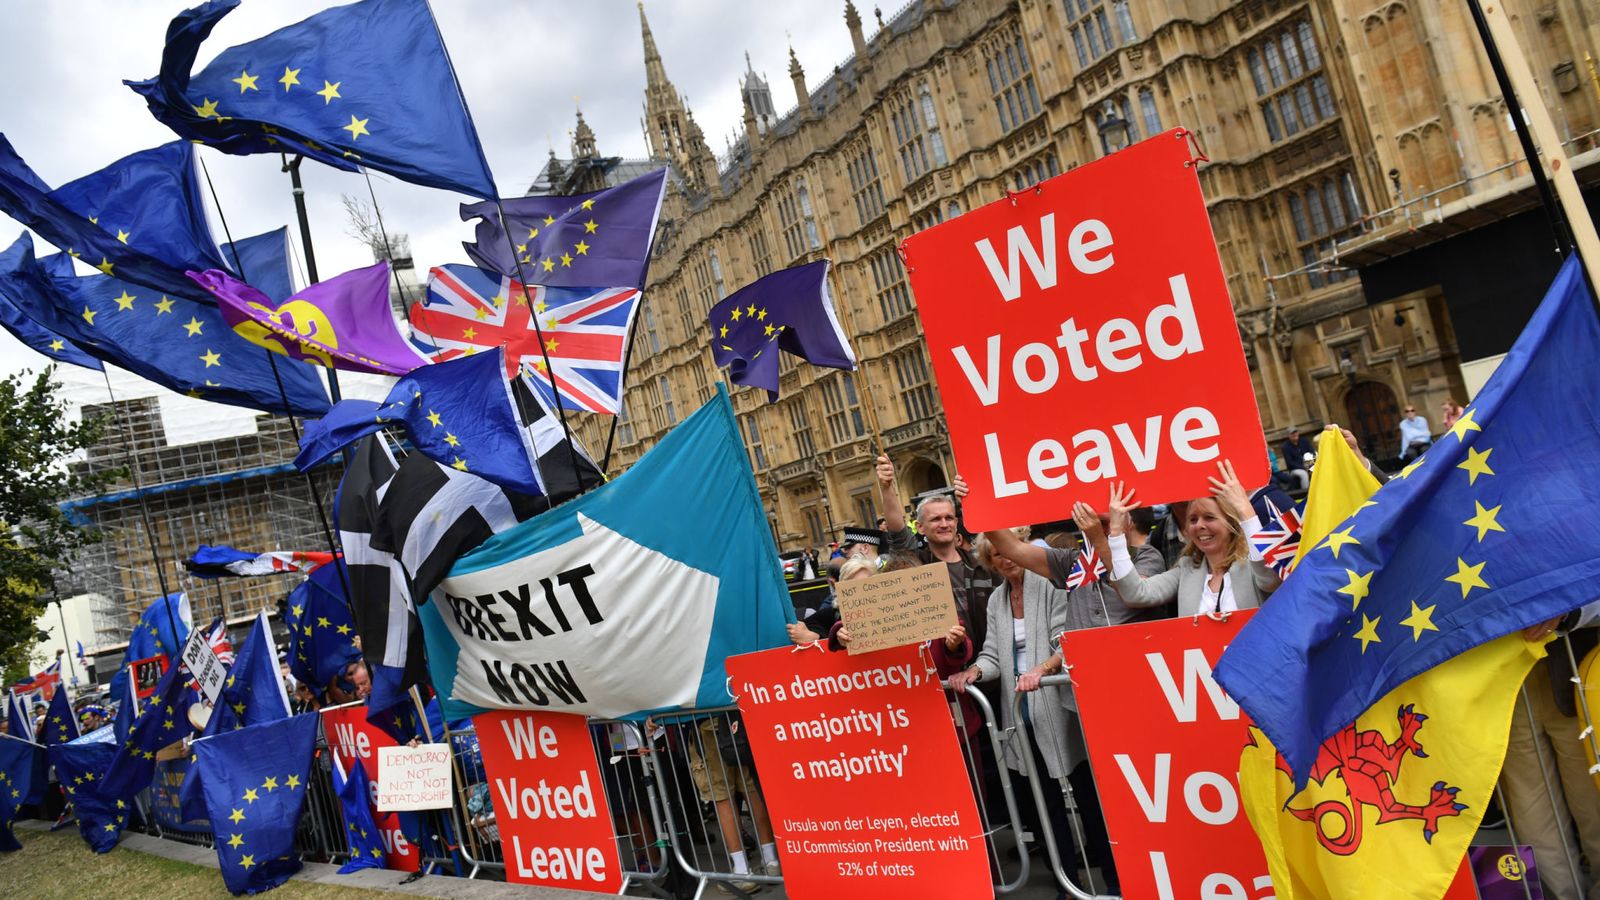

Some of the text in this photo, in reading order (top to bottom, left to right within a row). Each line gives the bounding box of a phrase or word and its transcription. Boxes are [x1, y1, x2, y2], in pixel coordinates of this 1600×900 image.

[974, 212, 1115, 302] We
[951, 273, 1204, 407] Voted
[983, 406, 1221, 499] Leave
[841, 571, 933, 598] NOT CONTENT WITH
[841, 581, 945, 610] FUCKING OTHER WOMEN
[445, 563, 604, 642] BREXIT
[844, 594, 931, 622] BORIS YOU WANT TO
[845, 621, 867, 632] FUCK
[883, 611, 910, 624] ENTIRE
[914, 604, 939, 616] NATION
[882, 620, 918, 635] BASTARD
[922, 613, 946, 623] STATE
[896, 634, 917, 643] WILL
[480, 660, 588, 706] NOW
[773, 683, 787, 701] a
[790, 663, 921, 699] democracy,
[1144, 648, 1241, 723] W
[774, 703, 910, 743] a majority is
[335, 722, 371, 758] We
[500, 716, 559, 761] We
[386, 751, 449, 767] DEMOCRACY
[791, 761, 806, 780] a
[389, 781, 415, 793] NOT
[423, 777, 448, 789] NOT
[407, 767, 433, 780] NOT
[381, 789, 450, 805] DICTATORSHIP
[495, 770, 597, 820] Voted
[783, 811, 960, 833] Ursula von der Leyen, elected
[512, 835, 607, 882] Leave
[786, 836, 969, 854] EU Commission President with
[837, 861, 915, 877] 52% of votes
